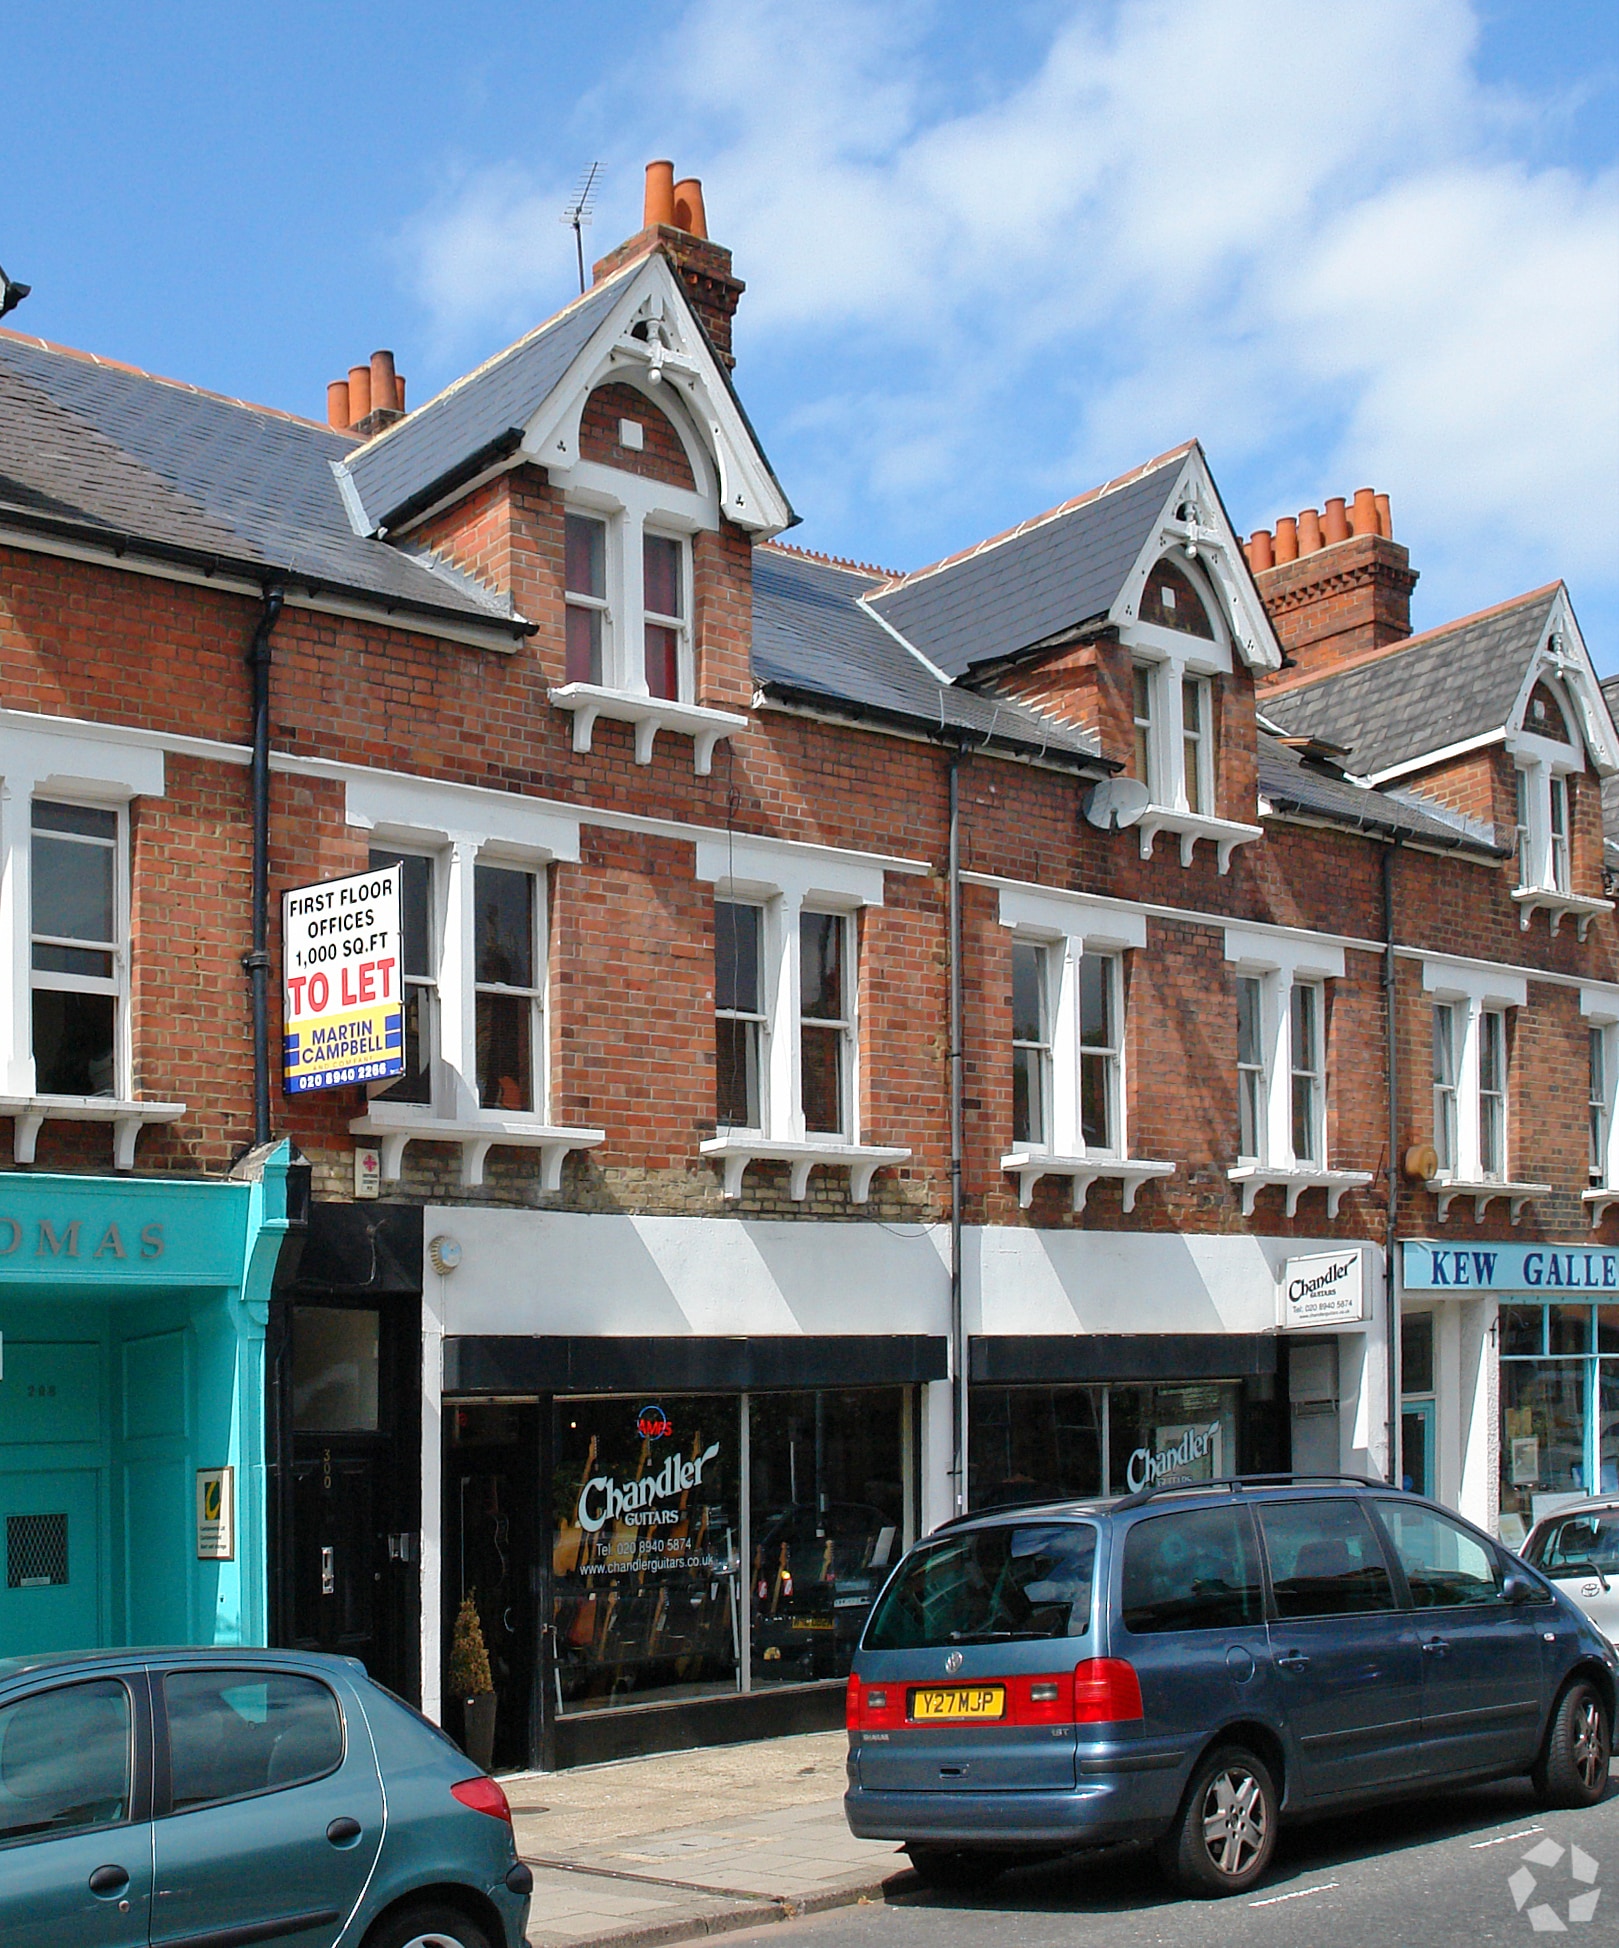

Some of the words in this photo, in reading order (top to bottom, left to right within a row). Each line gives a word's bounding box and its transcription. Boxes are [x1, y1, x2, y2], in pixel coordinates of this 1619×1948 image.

[290, 892, 335, 917] FIRST
[340, 879, 392, 906] FLOOR
[308, 909, 374, 938] OFFICES
[296, 943, 337, 969] 1,000
[343, 931, 388, 957] SQ.FT
[288, 972, 329, 1015] TO
[341, 957, 396, 1005] LET
[312, 1019, 373, 1045] MARTIN
[302, 1034, 383, 1064] CAMPBELL
[313, 1062, 330, 1071] AND
[332, 1055, 374, 1068] COMPANY
[300, 1075, 322, 1089] 020
[325, 1068, 355, 1085] 8940
[1288, 1255, 1358, 1303] Chandler
[1431, 1250, 1498, 1286] KEW
[1523, 1253, 1616, 1287] GALLE
[1305, 1303, 1317, 1312] 020
[1336, 1299, 1353, 1309] 5874
[638, 1419, 673, 1437] AMPS
[1126, 1420, 1220, 1494] Chandler
[578, 1441, 720, 1533] Chandler
[624, 1509, 680, 1527] GUITARS
[616, 1541, 636, 1556] 020
[639, 1539, 665, 1554] 8940
[667, 1537, 692, 1552] 5874
[580, 1553, 714, 1576] www.chandlerguitars.co.uk
